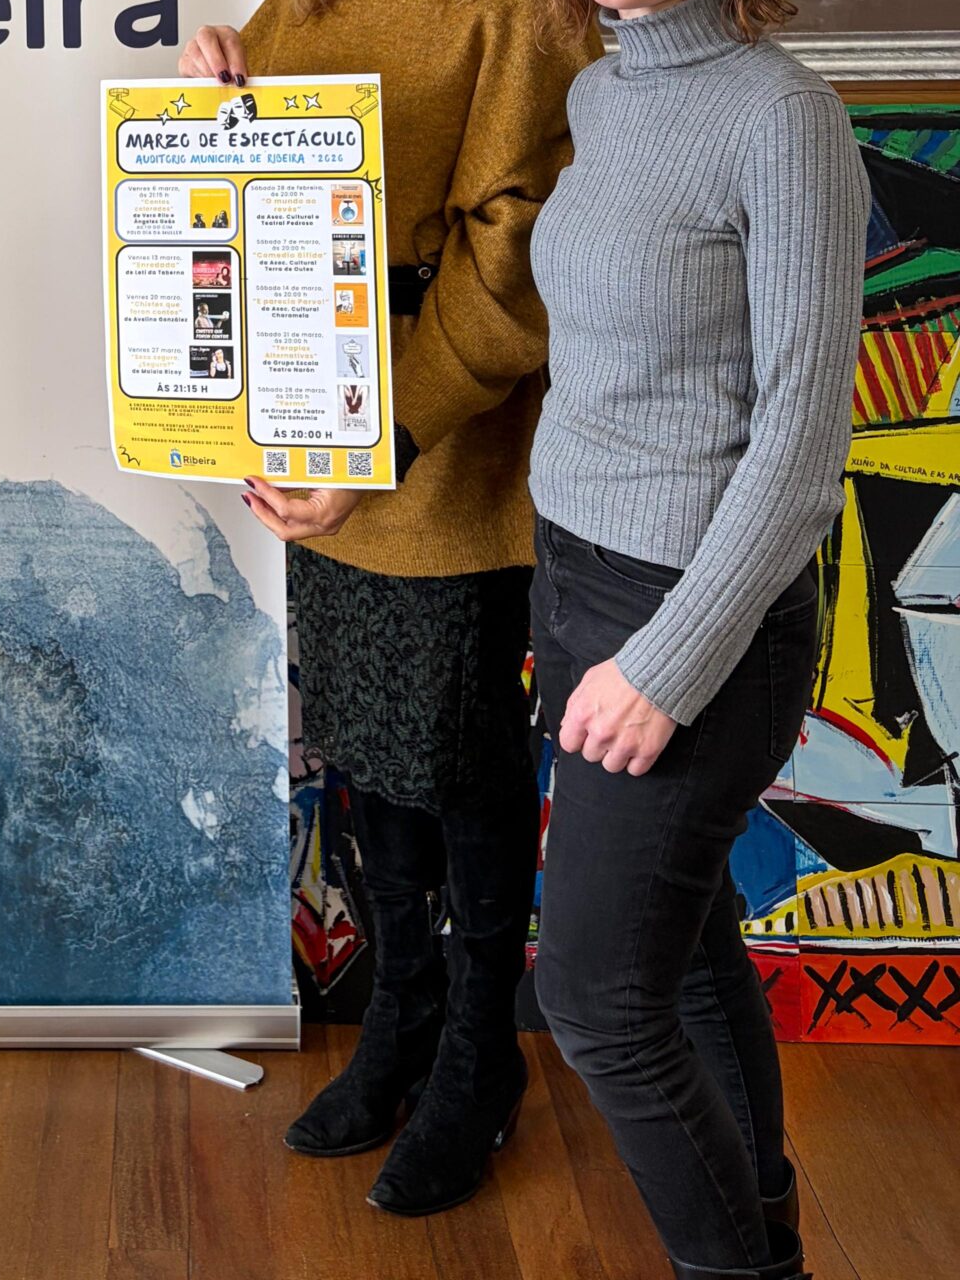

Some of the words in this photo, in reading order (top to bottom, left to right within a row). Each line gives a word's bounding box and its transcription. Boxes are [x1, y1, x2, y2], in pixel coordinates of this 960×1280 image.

[126, 133, 189, 149] MARZO
[200, 133, 217, 147] DE
[229, 129, 355, 147] ESPECTÁCULO
[136, 154, 186, 164] AUDITORIO
[191, 154, 244, 163] MUNICIPAL
[250, 154, 261, 163] DE
[267, 153, 304, 164] RIBEIRA
[157, 383, 169, 392] ÁS
[201, 385, 207, 393] H
[273, 428, 287, 438] ÁS
[183, 456, 216, 465] Ribeira
[851, 456, 875, 467] XUÑO
[880, 462, 890, 471] DA
[894, 465, 927, 477] CULTURA
